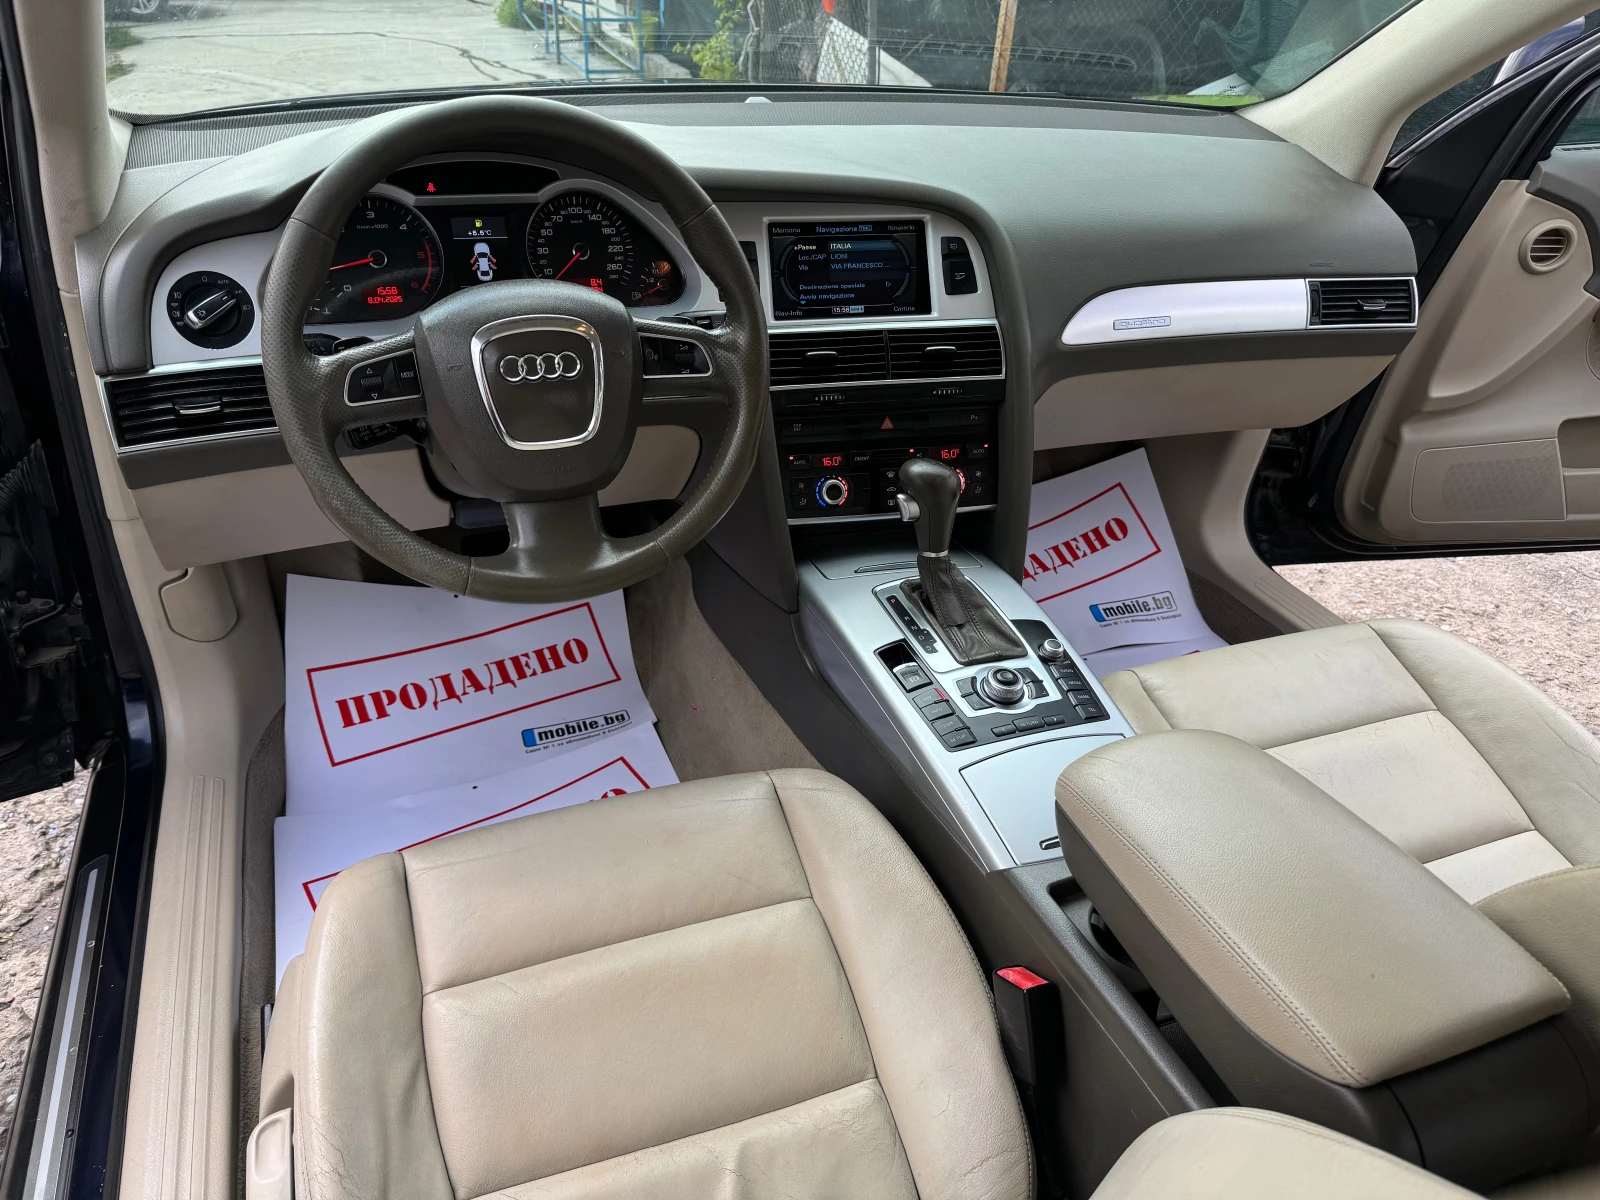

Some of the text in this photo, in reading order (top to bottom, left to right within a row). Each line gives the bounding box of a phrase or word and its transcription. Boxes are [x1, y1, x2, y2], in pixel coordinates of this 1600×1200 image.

[377, 287, 398, 295] 15:58
[400, 371, 415, 379] MODE
[1101, 596, 1174, 618] mobile.bg
[334, 637, 589, 729] ПРОДАДЕНО
[537, 713, 626, 742] mobile.bg
